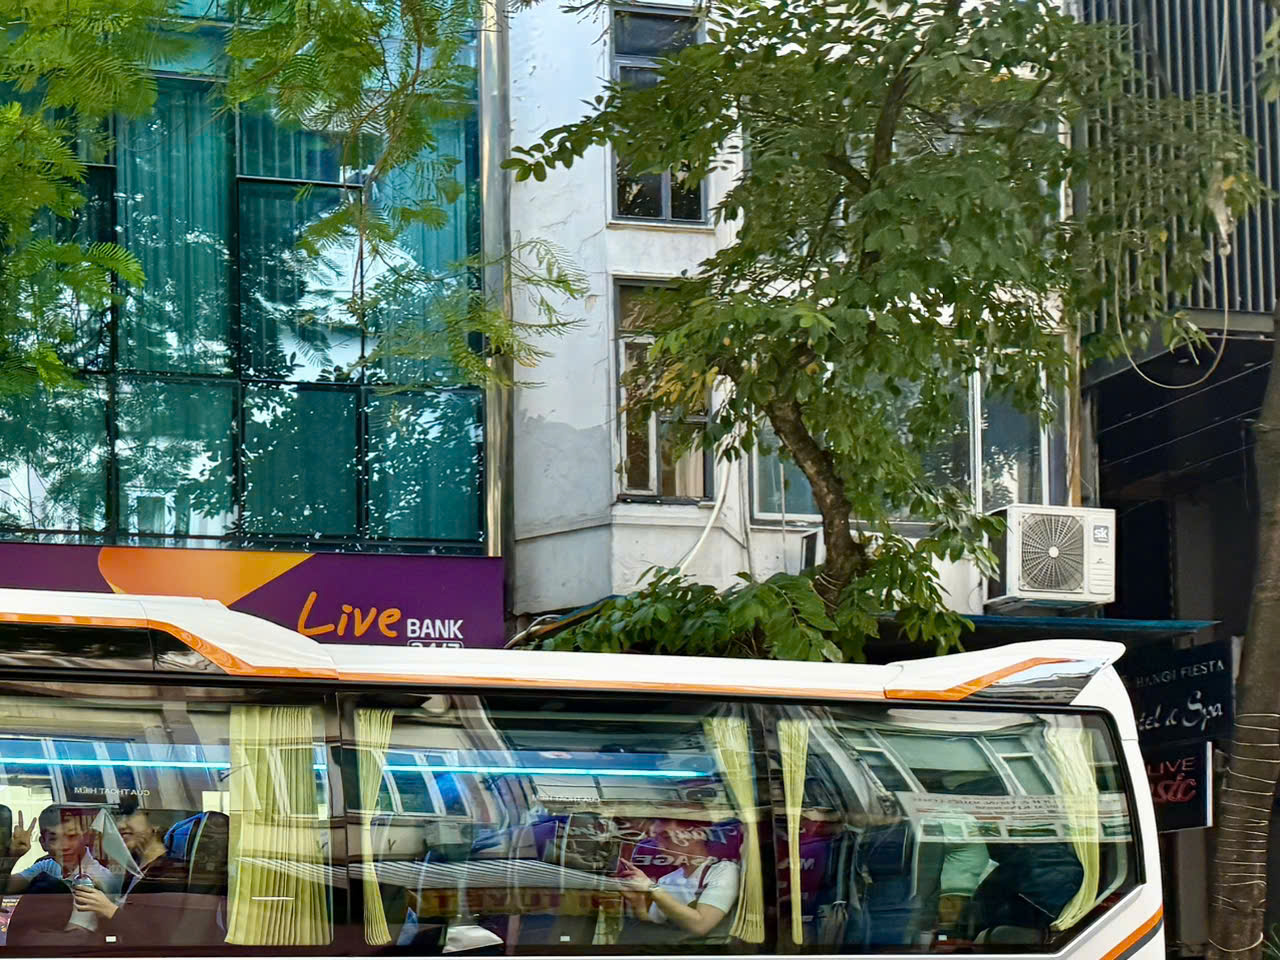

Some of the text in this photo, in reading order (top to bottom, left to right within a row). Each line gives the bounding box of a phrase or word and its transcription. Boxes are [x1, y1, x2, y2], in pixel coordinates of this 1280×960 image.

[297, 591, 464, 639] Live BANK
[1147, 756, 1196, 777] LIVE
